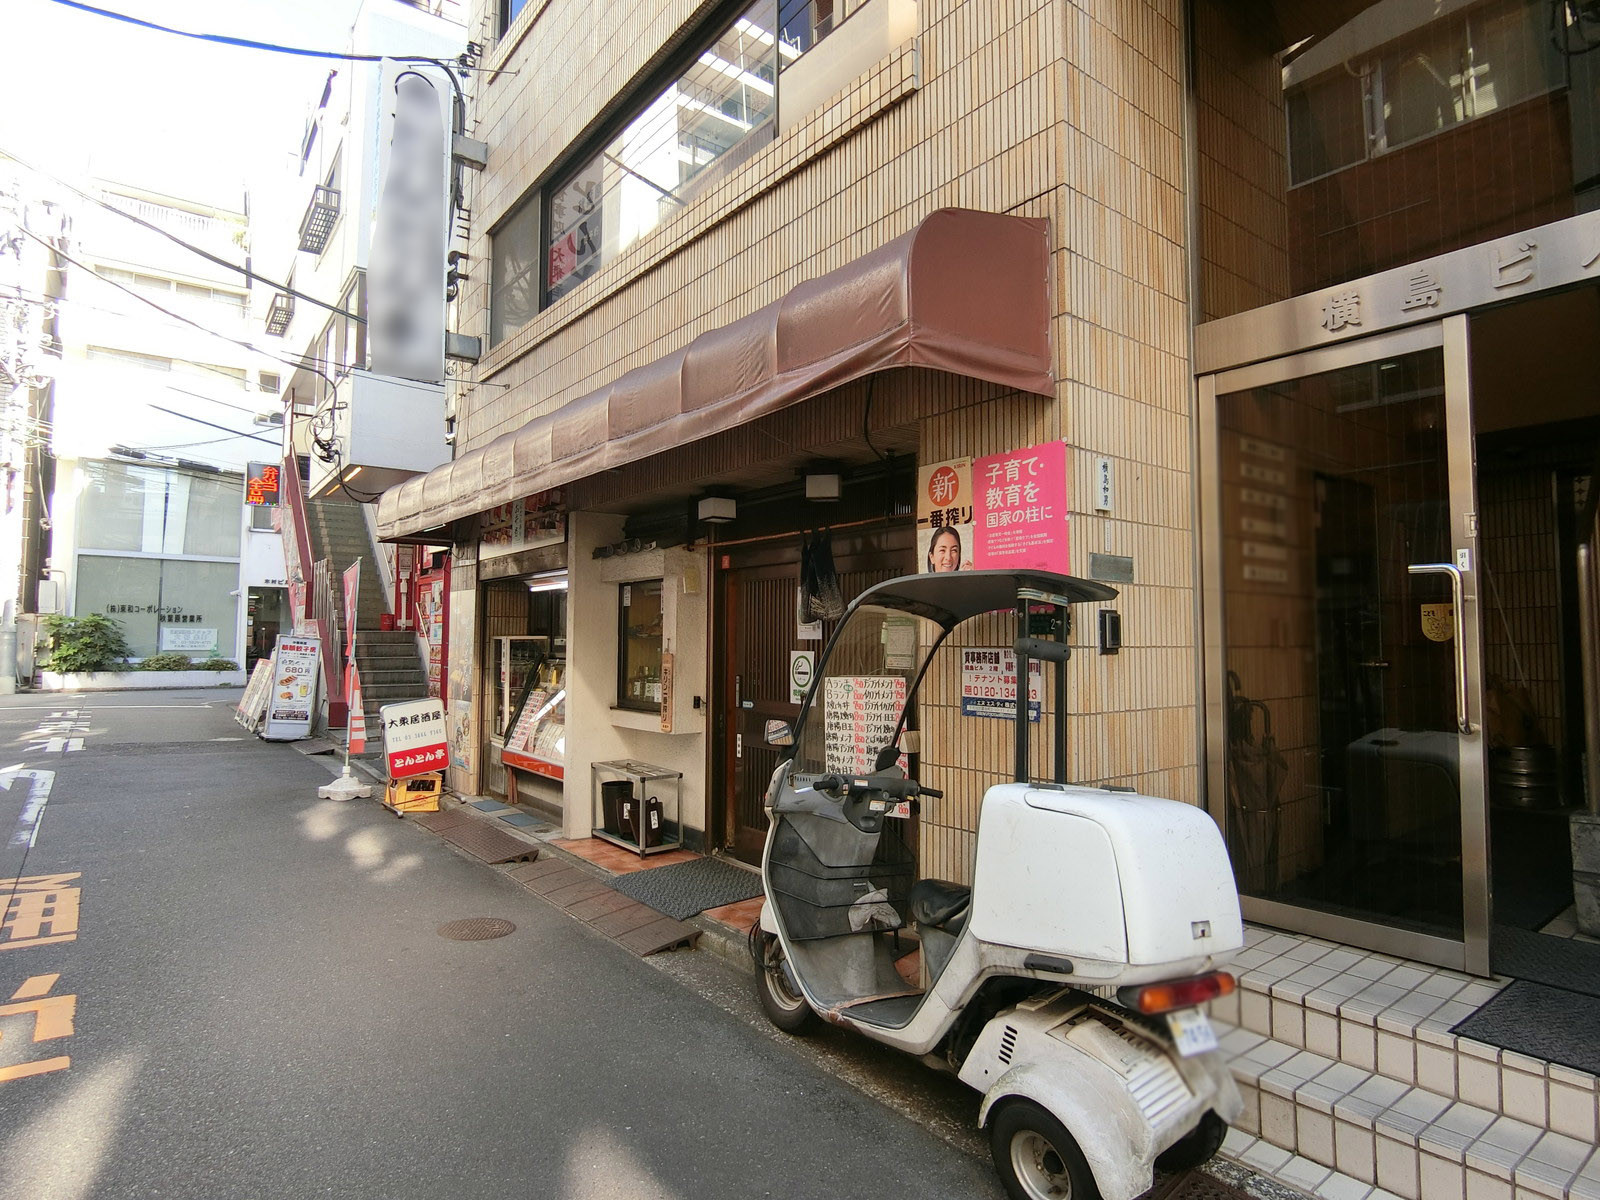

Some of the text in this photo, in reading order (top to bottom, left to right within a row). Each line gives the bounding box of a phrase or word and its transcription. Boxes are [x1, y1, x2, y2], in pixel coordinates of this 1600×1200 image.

[932, 472, 956, 502] 新
[985, 481, 1040, 510] 教育を
[917, 505, 973, 529] 一番搾り
[986, 505, 1054, 528] 国家の柱に
[388, 710, 442, 729] 大衆居酒屋
[394, 748, 446, 768] とんとん亭
